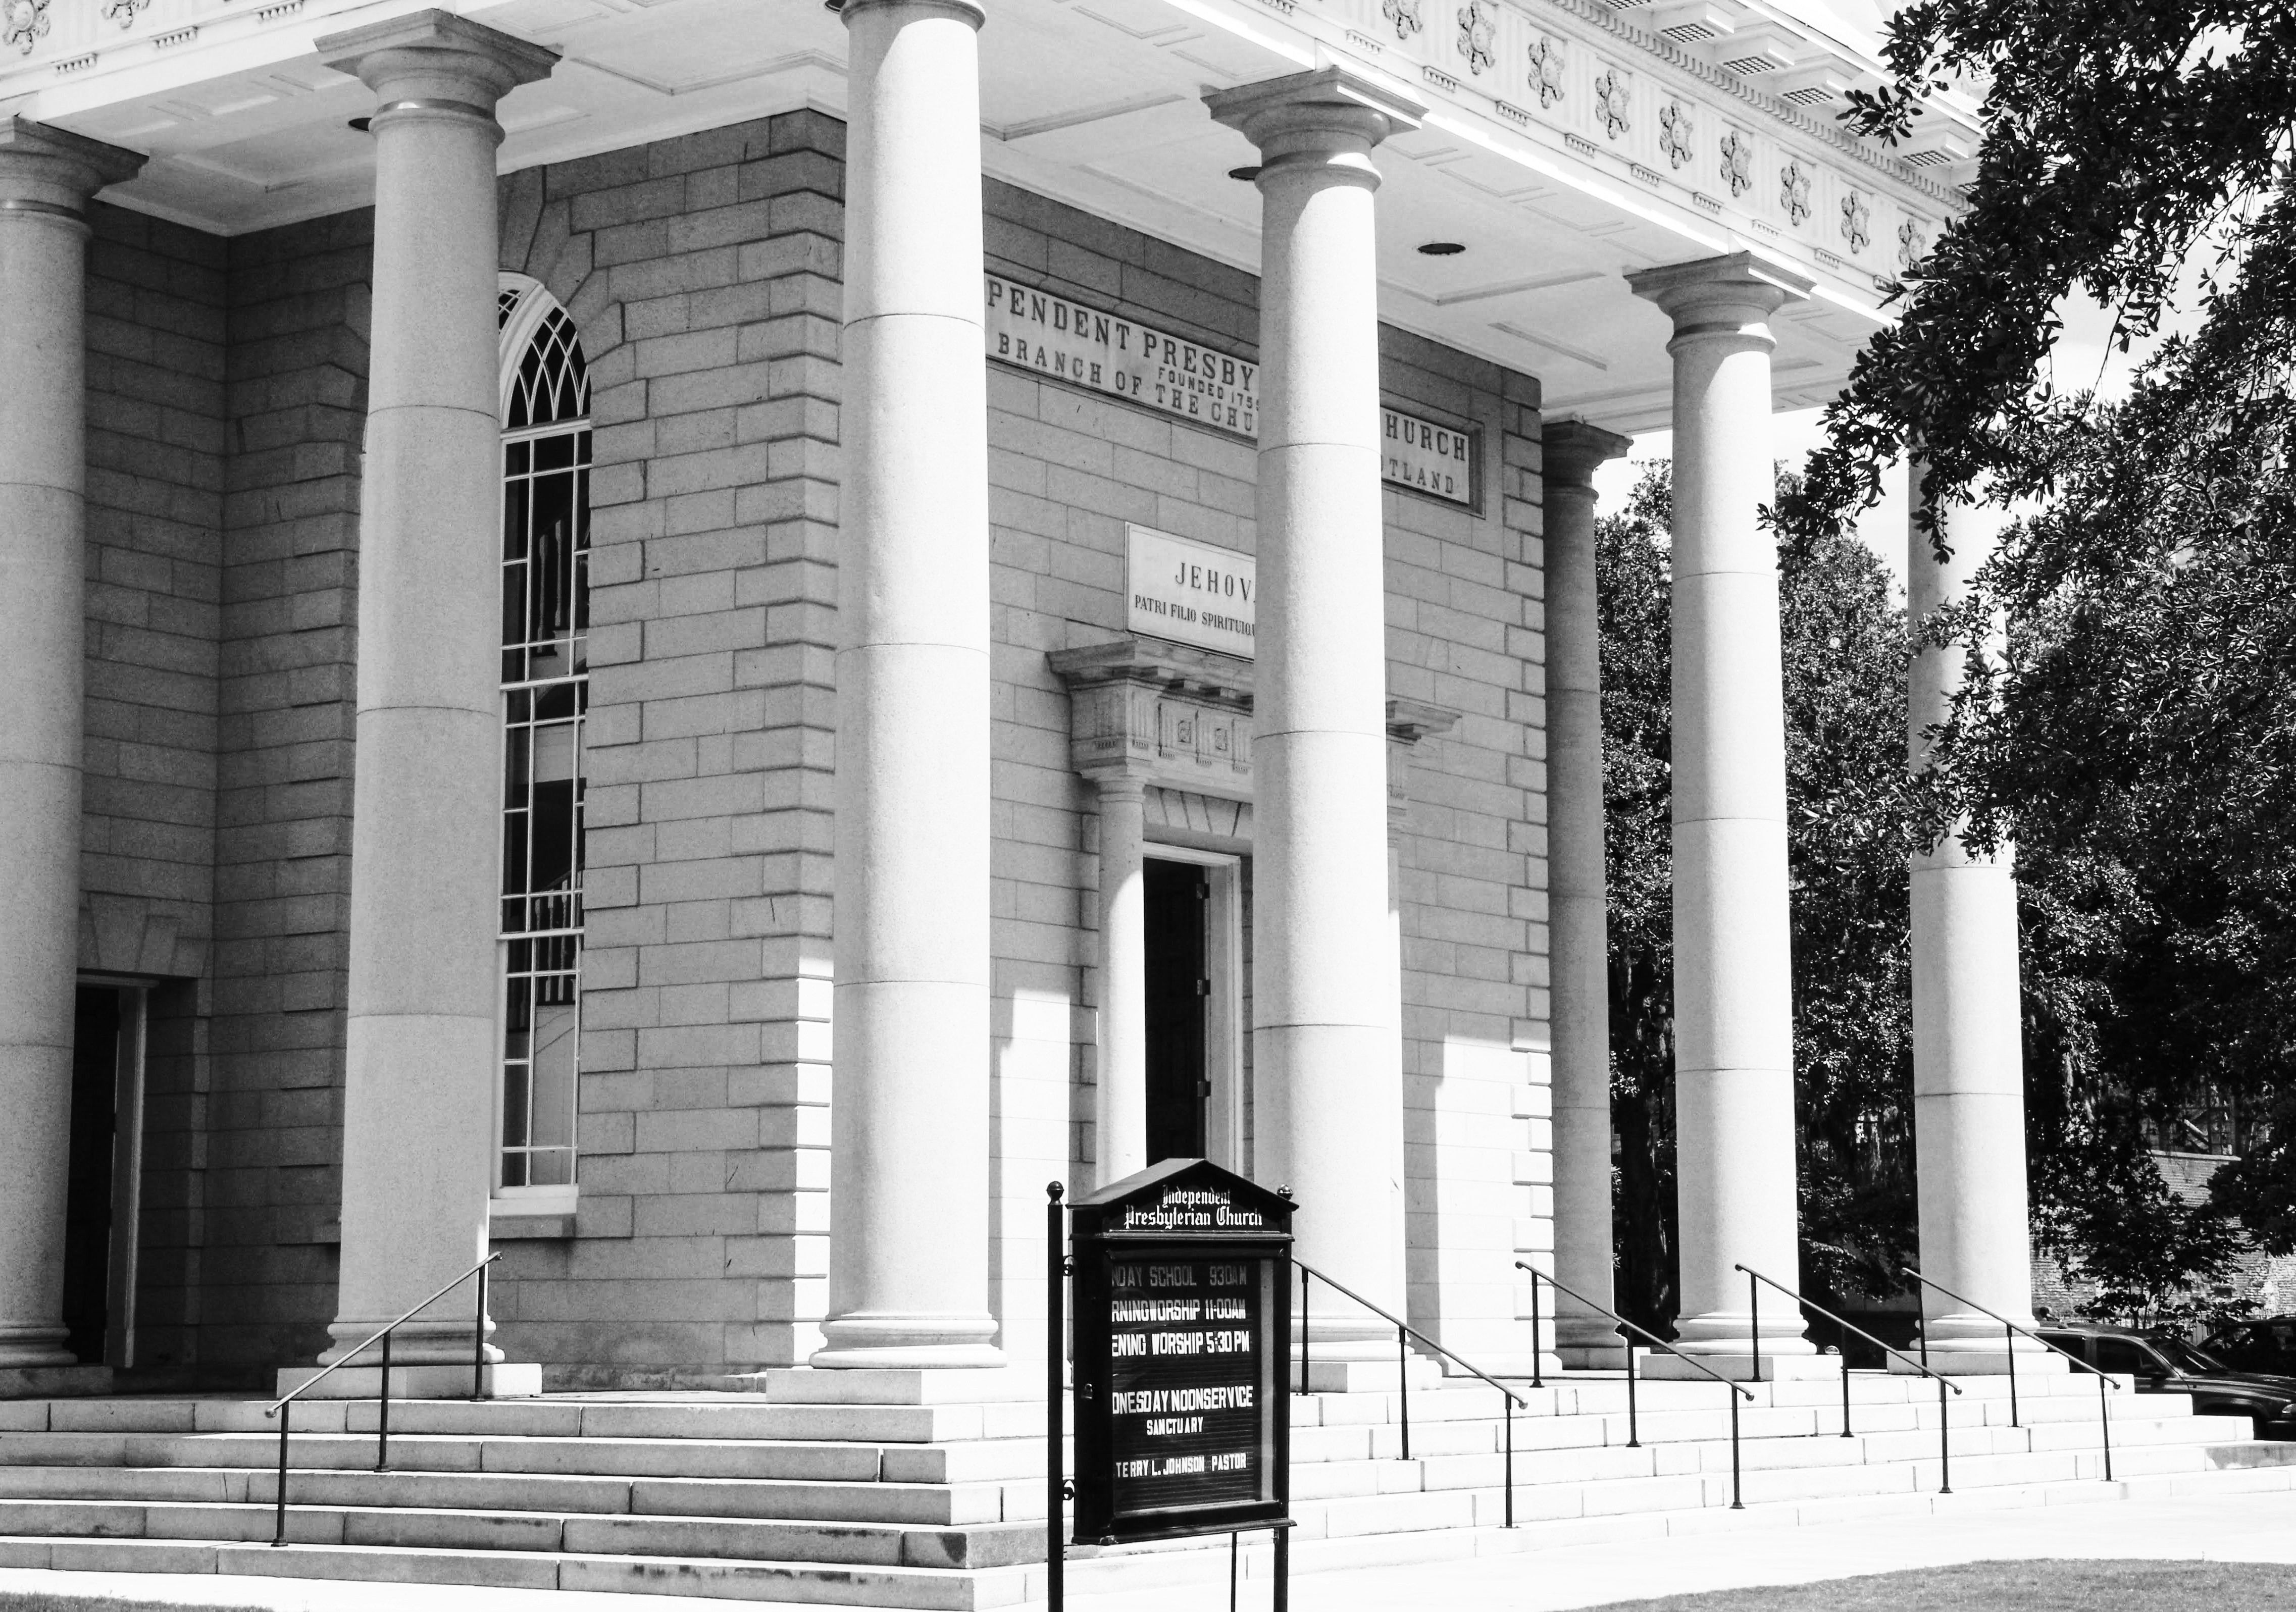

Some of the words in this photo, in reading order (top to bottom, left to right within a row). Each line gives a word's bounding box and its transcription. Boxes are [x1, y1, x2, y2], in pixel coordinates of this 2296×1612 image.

[987, 279, 1130, 350] PENDENT
[1143, 331, 1253, 392] PRESBY
[1385, 413, 1465, 461] HURCH
[1158, 367, 1224, 400] FOUNDED
[998, 332, 1101, 384] BRANCH
[1115, 371, 1142, 395] OF
[1155, 383, 1198, 415] THE
[1211, 402, 1253, 432] CHU
[1381, 456, 1453, 494] TLAND
[1175, 562, 1255, 603] JEHOV
[1135, 595, 1166, 615] PATRI
[1170, 604, 1197, 622] FILIO
[1162, 1184, 1231, 1209] Independent
[1124, 1204, 1211, 1230] Presbyterian
[1216, 1205, 1262, 1226] Church
[1149, 1265, 1197, 1287] SCHOOL
[1112, 1333, 1147, 1357] ENING
[1151, 1332, 1204, 1356] WORSHIP
[1205, 1331, 1233, 1354] 5:30
[1234, 1330, 1250, 1352] PM
[1112, 1390, 1169, 1414] DNESDAY
[1146, 1416, 1204, 1436] SANCTUARY
[1115, 1459, 1149, 1478] TERRY
[1151, 1460, 1161, 1477] L.
[1162, 1455, 1205, 1476] JOHNSON
[1211, 1452, 1247, 1472] PASTOR
